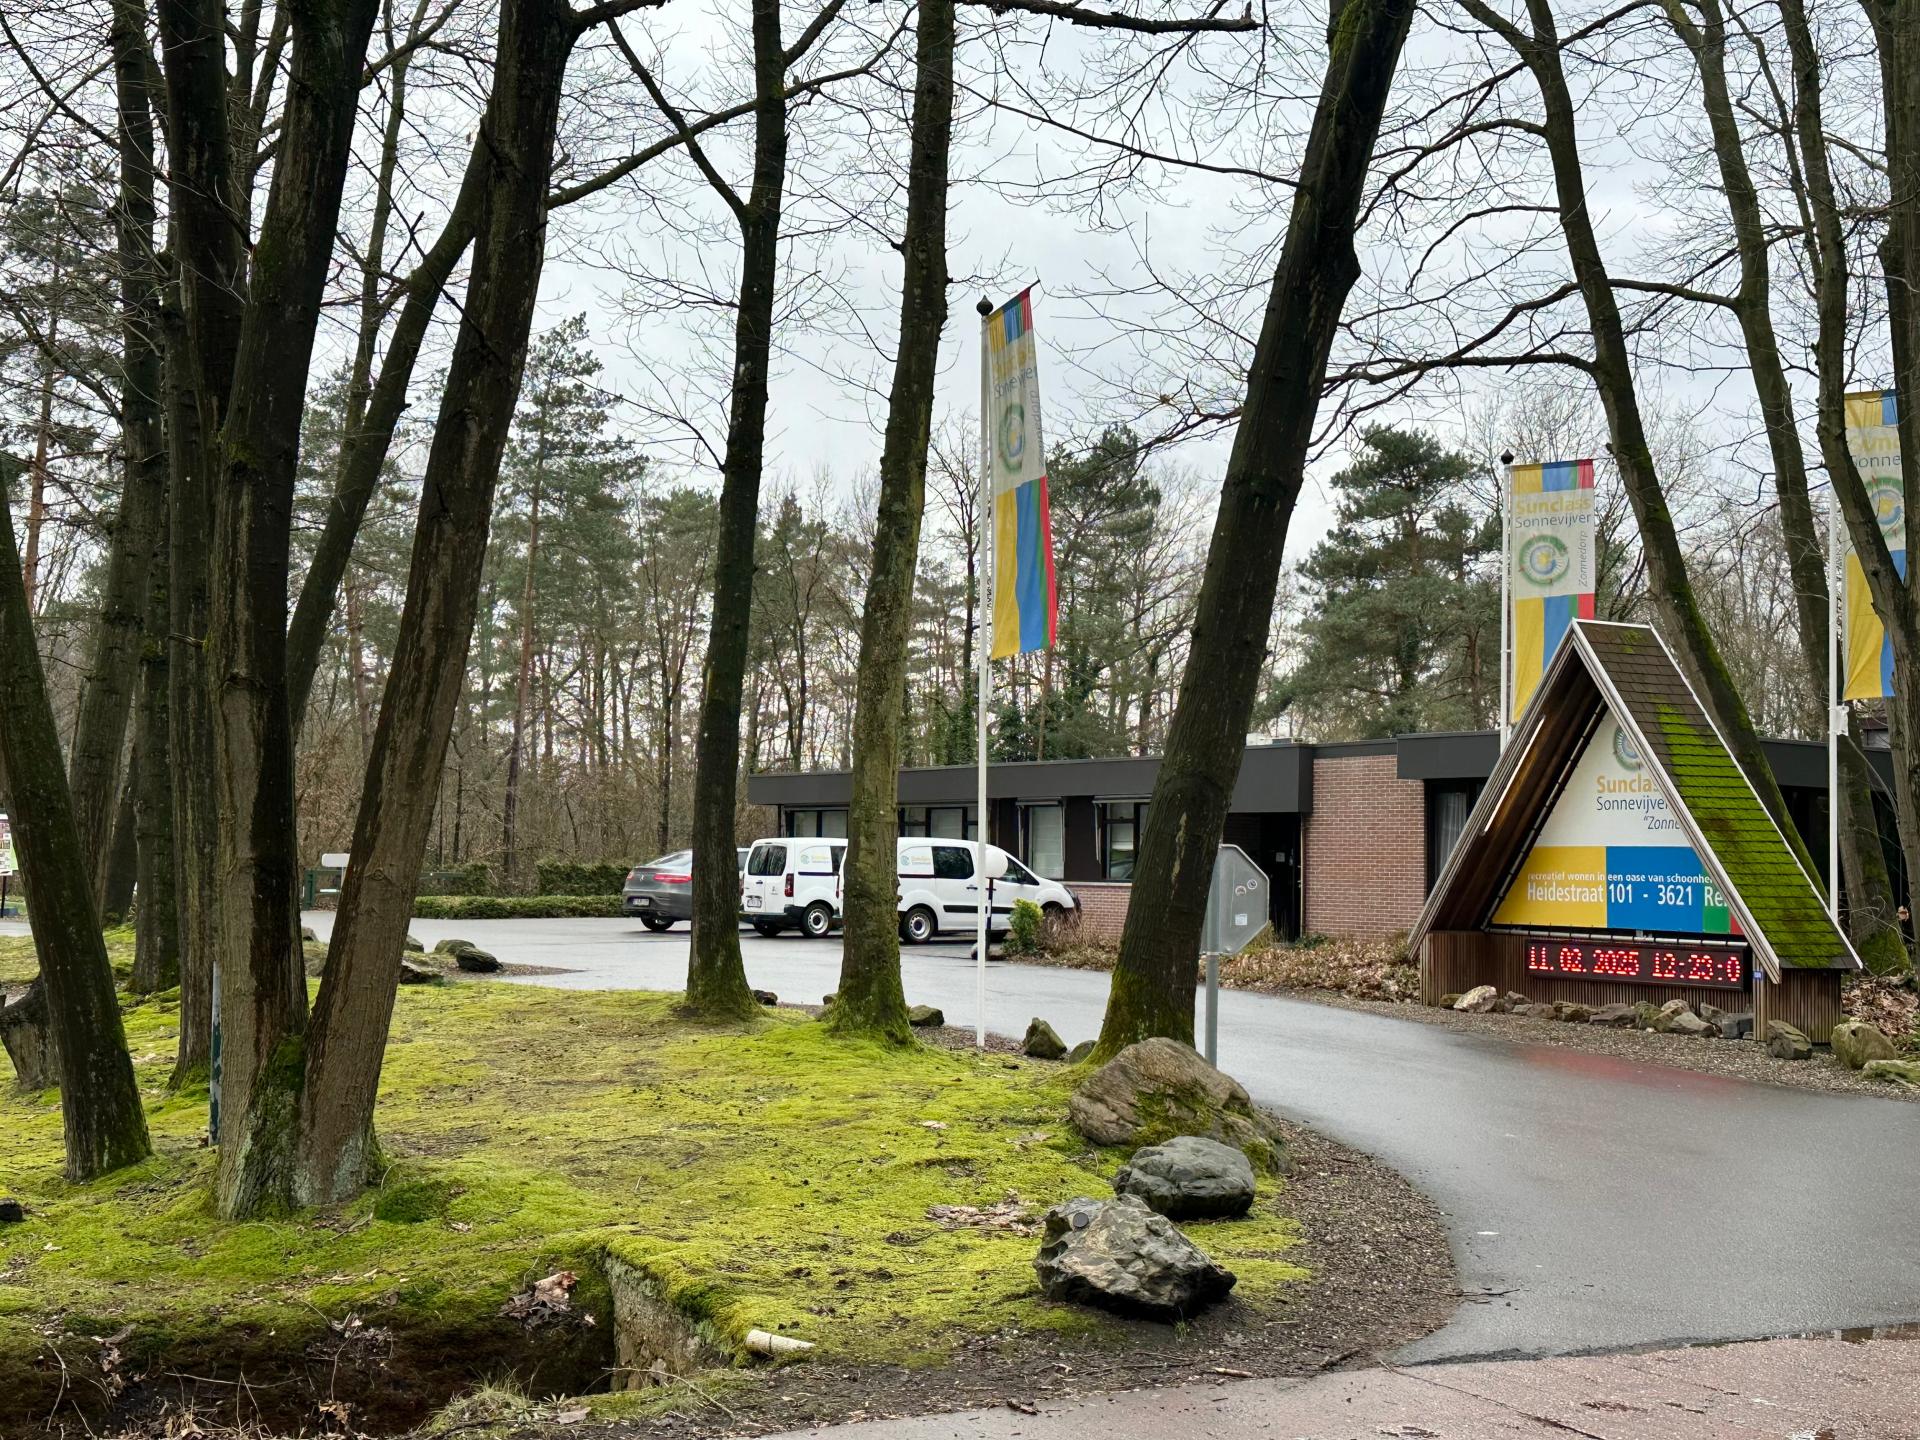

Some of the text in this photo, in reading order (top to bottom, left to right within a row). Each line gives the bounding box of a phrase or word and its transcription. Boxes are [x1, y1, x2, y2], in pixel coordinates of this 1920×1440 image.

[1516, 496, 1591, 514] Sunclass
[1515, 513, 1591, 528] Sonnevijver
[1578, 530, 1588, 588] Zonnedorp
[1527, 872, 1565, 881] recreatief
[1567, 873, 1595, 881] wonen
[1597, 872, 1605, 881] in
[1607, 874, 1623, 882] een
[1625, 874, 1646, 882] oase
[1527, 881, 1604, 903] Heidestraat
[1609, 883, 1633, 904] 101
[1657, 885, 1693, 906] 3621
